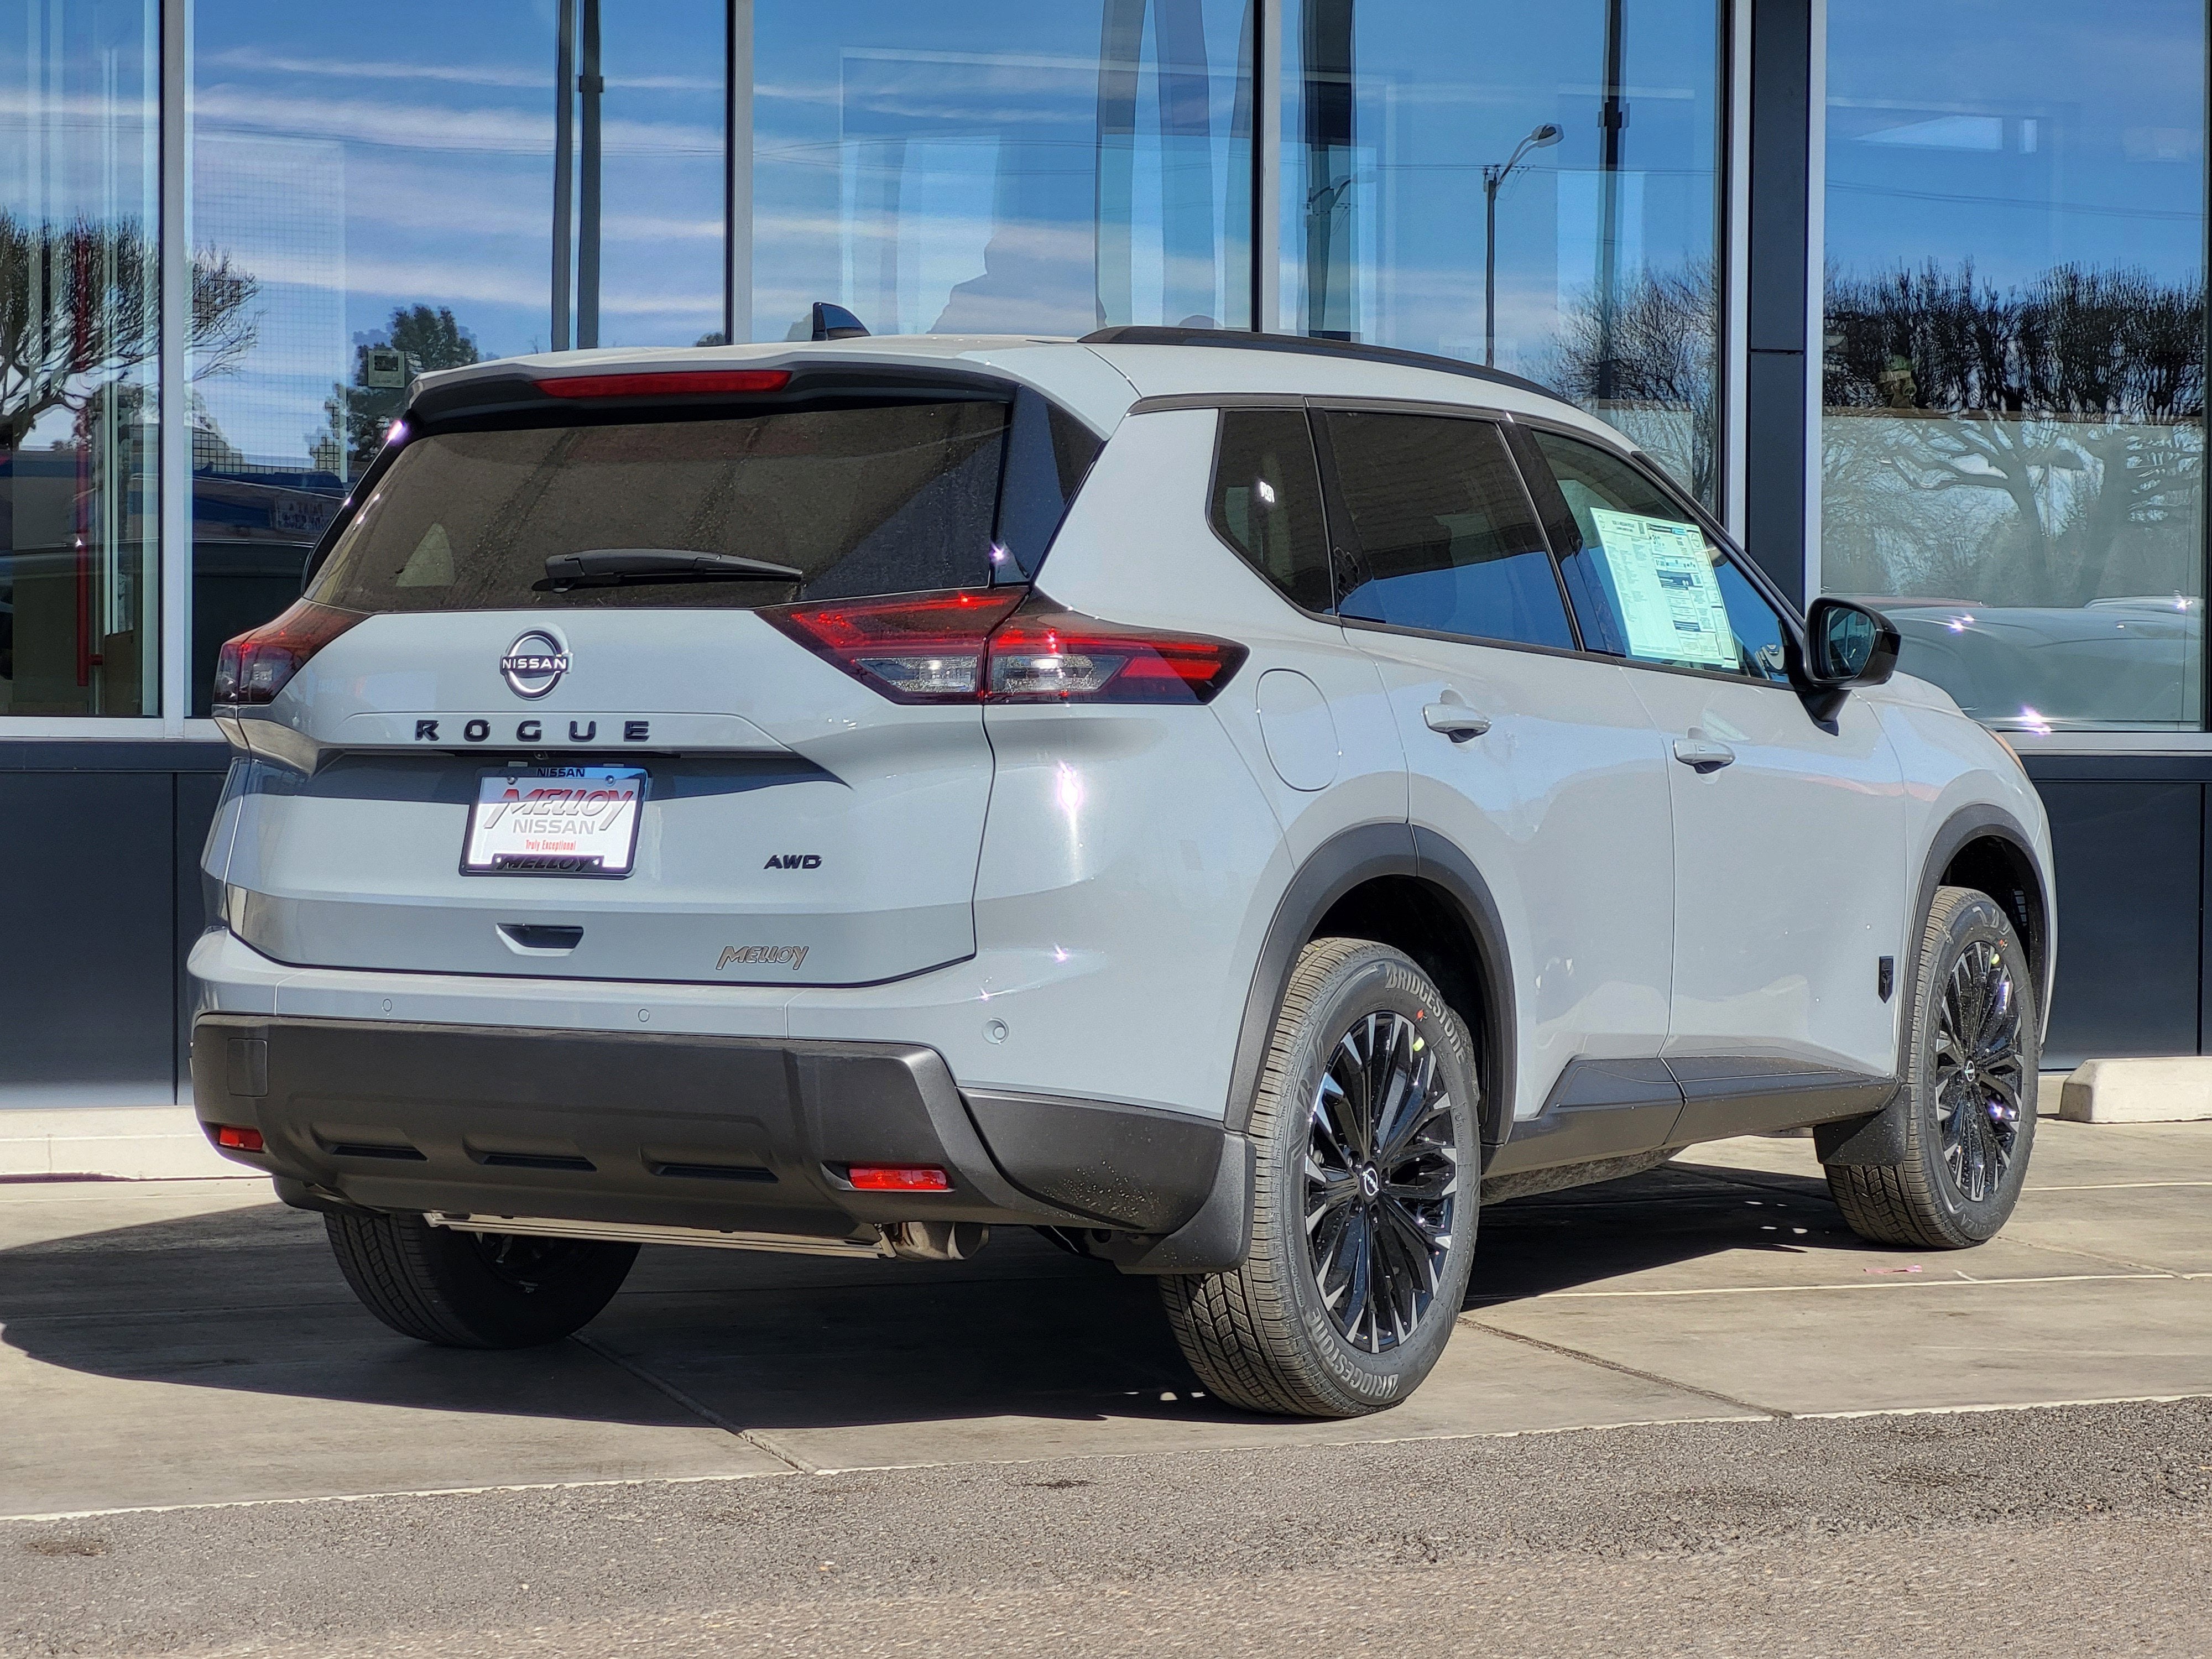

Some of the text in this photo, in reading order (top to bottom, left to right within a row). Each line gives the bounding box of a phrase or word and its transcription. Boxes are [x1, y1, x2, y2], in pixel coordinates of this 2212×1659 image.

[502, 657, 567, 670] NISSAN
[415, 719, 651, 742] ROGUE
[537, 768, 585, 778] NISSAN
[484, 789, 634, 831] MELLOY
[513, 818, 596, 834] NISSAN
[525, 839, 577, 852] Truly Exceptional
[497, 857, 589, 872] MELLOY
[763, 854, 822, 870] AWD
[715, 946, 810, 971] MELLOY
[1384, 960, 1467, 1065] BRIDGESTONE
[1306, 1306, 1399, 1400] BRIDGESTONE
